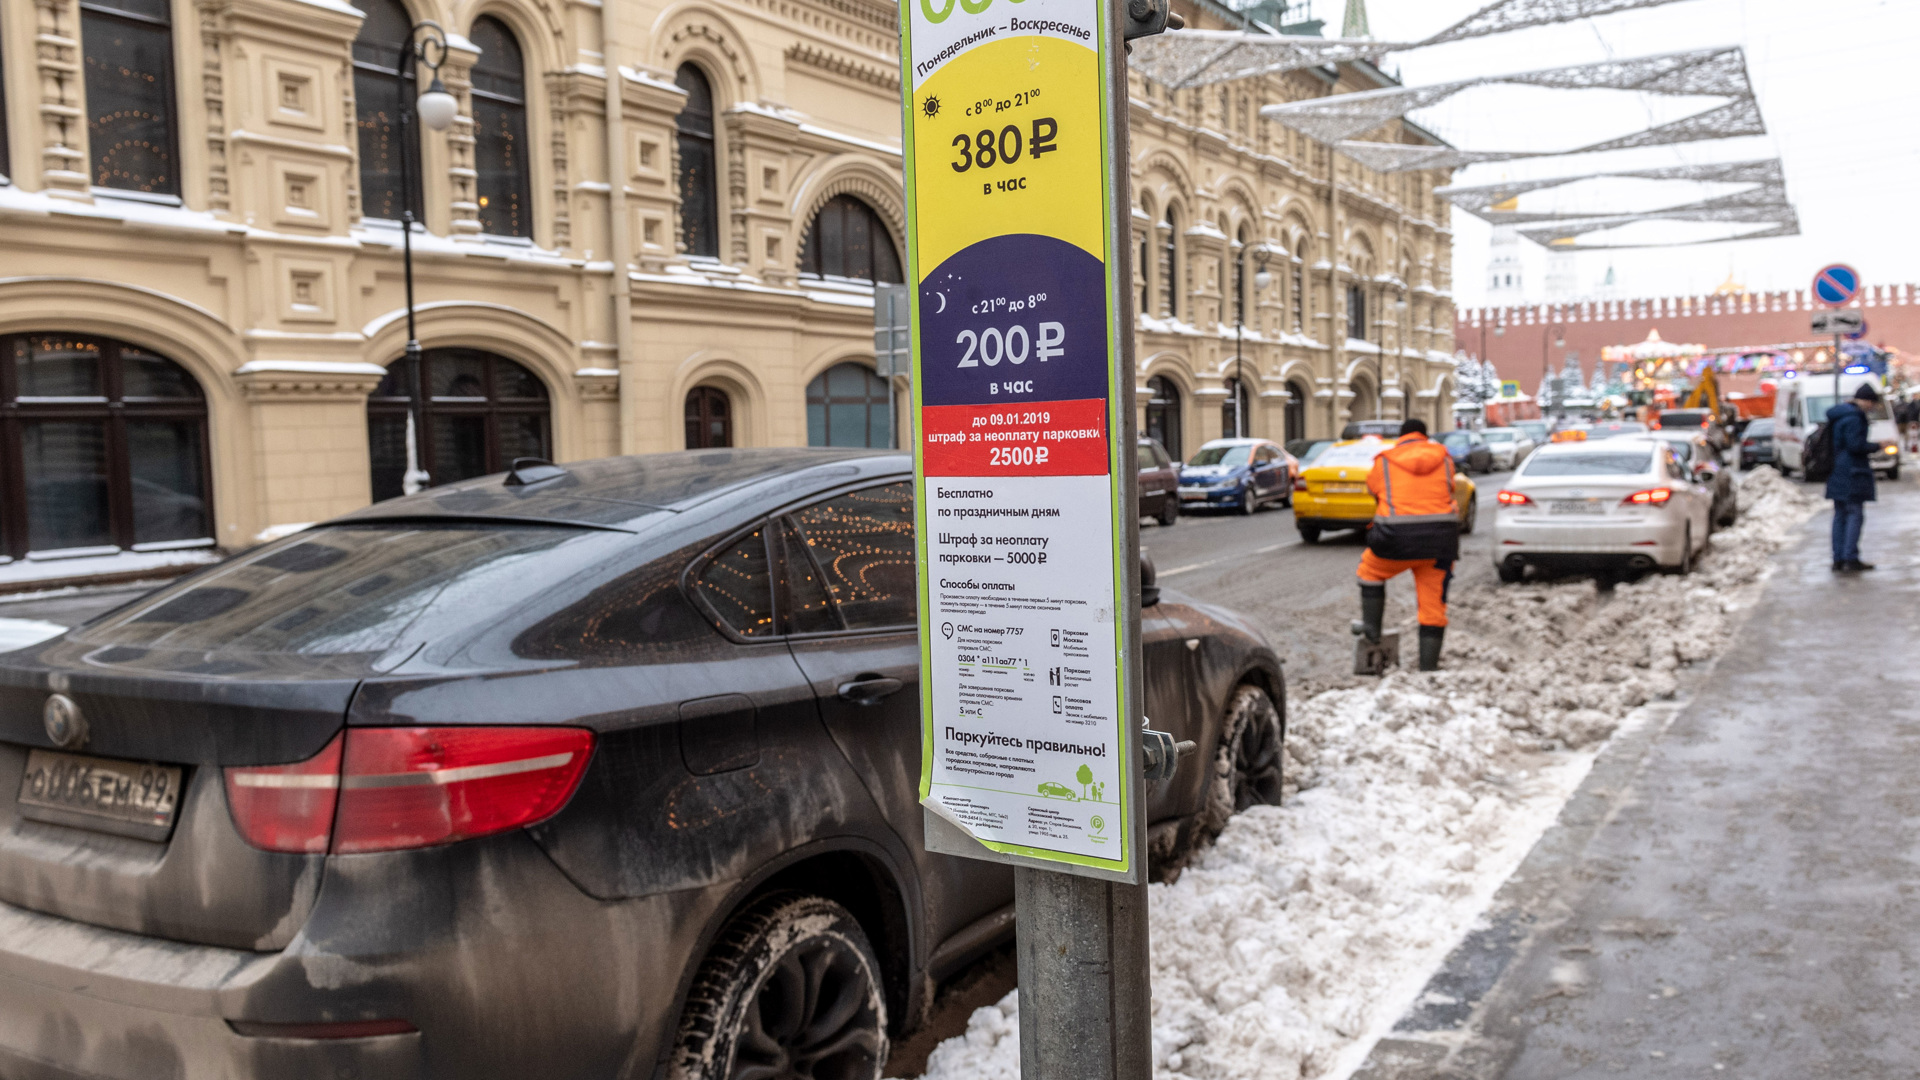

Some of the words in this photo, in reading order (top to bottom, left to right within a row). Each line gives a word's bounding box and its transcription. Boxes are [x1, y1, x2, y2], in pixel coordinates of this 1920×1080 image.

[917, 24, 996, 77] Понедельник
[1010, 18, 1091, 41] Воскресенье
[995, 98, 1011, 113] до
[983, 184, 992, 195] в
[997, 176, 1027, 194] час
[1008, 300, 1024, 312] до
[990, 383, 998, 395] в
[1003, 380, 1034, 394] час
[972, 417, 987, 428] до
[990, 412, 1050, 426] 09.01.2019
[928, 431, 966, 444] штраф
[969, 432, 981, 442] за
[984, 430, 1039, 443] неоплату
[1043, 428, 1100, 442] парковки
[937, 487, 994, 499] Бесплатно
[938, 508, 951, 516] по
[953, 508, 1029, 519] праздничным
[1031, 508, 1060, 519] дням
[938, 532, 977, 547] Штраф
[980, 536, 993, 545] за
[995, 536, 1049, 549] неоплату
[939, 553, 991, 566] парковки
[940, 578, 980, 590] Способы
[982, 582, 1015, 590] оплаты
[957, 624, 973, 632] СМС
[984, 628, 1005, 636] номер
[1006, 627, 1024, 636] 7757
[958, 654, 975, 662] 0304
[945, 727, 1023, 748] Паркуйтесь
[1026, 739, 1106, 757] правильно!
